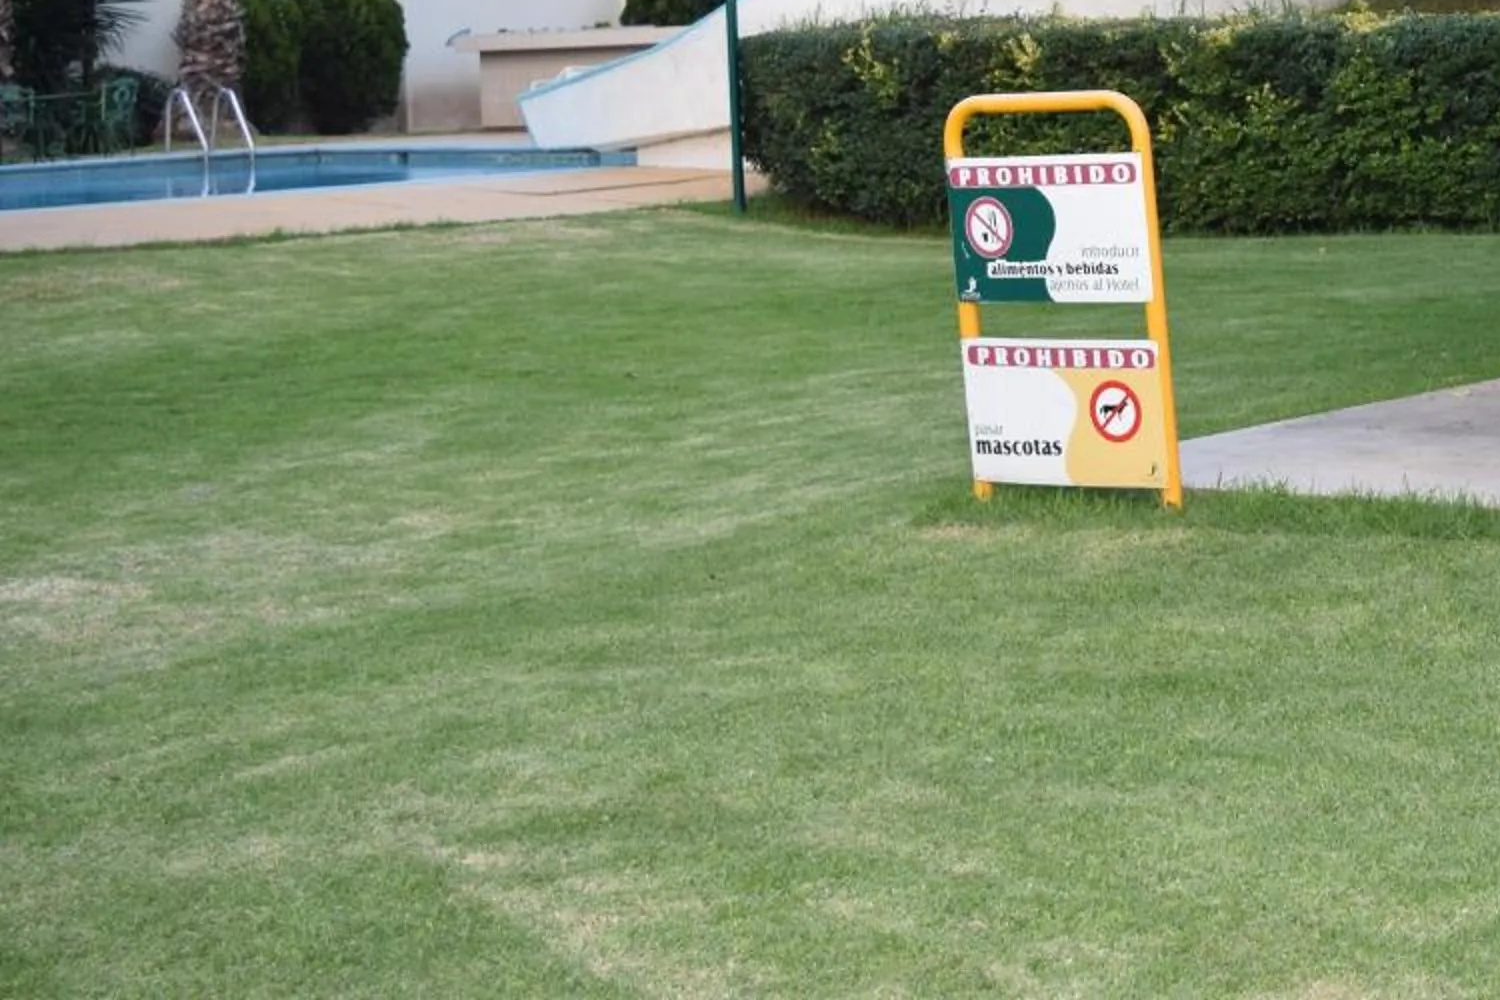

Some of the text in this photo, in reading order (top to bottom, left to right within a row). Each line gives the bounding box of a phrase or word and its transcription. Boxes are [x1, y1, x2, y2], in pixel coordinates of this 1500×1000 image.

[957, 164, 1132, 186] PROHIBIDO
[991, 262, 1054, 275] alimentos
[1065, 261, 1119, 275] bebidas
[976, 346, 1150, 368] PROHIBIDO
[976, 439, 1062, 456] mascotas
